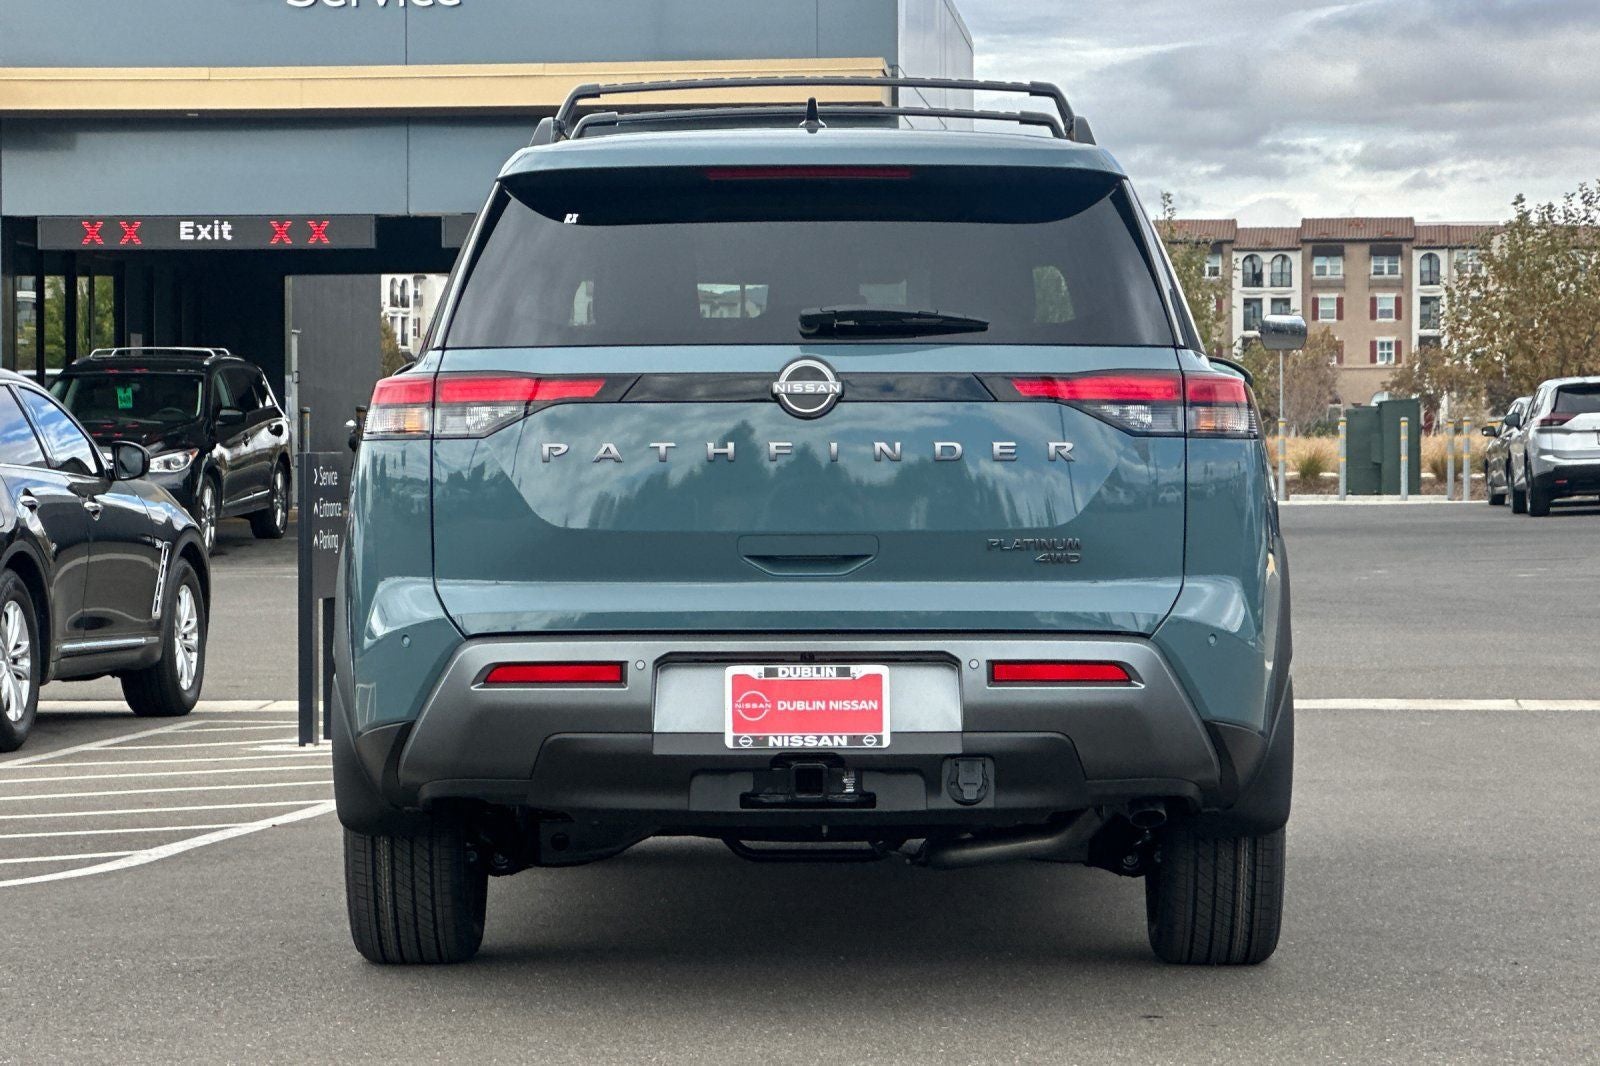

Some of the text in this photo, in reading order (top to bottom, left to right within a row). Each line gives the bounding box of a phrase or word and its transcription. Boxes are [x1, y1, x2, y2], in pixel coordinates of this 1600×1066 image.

[179, 219, 233, 241] Exit
[774, 383, 840, 393] NISSAN
[541, 441, 1076, 463] PATHFINDER
[319, 465, 338, 486] Service
[319, 498, 342, 518] Entrance
[319, 529, 339, 554] Parking
[986, 538, 1081, 551] PLATINUM
[1034, 552, 1081, 564] 4WD
[777, 666, 837, 678] DUBLIN
[777, 701, 878, 710] DUBLIN NISSAN
[768, 735, 848, 747] NISSAN
